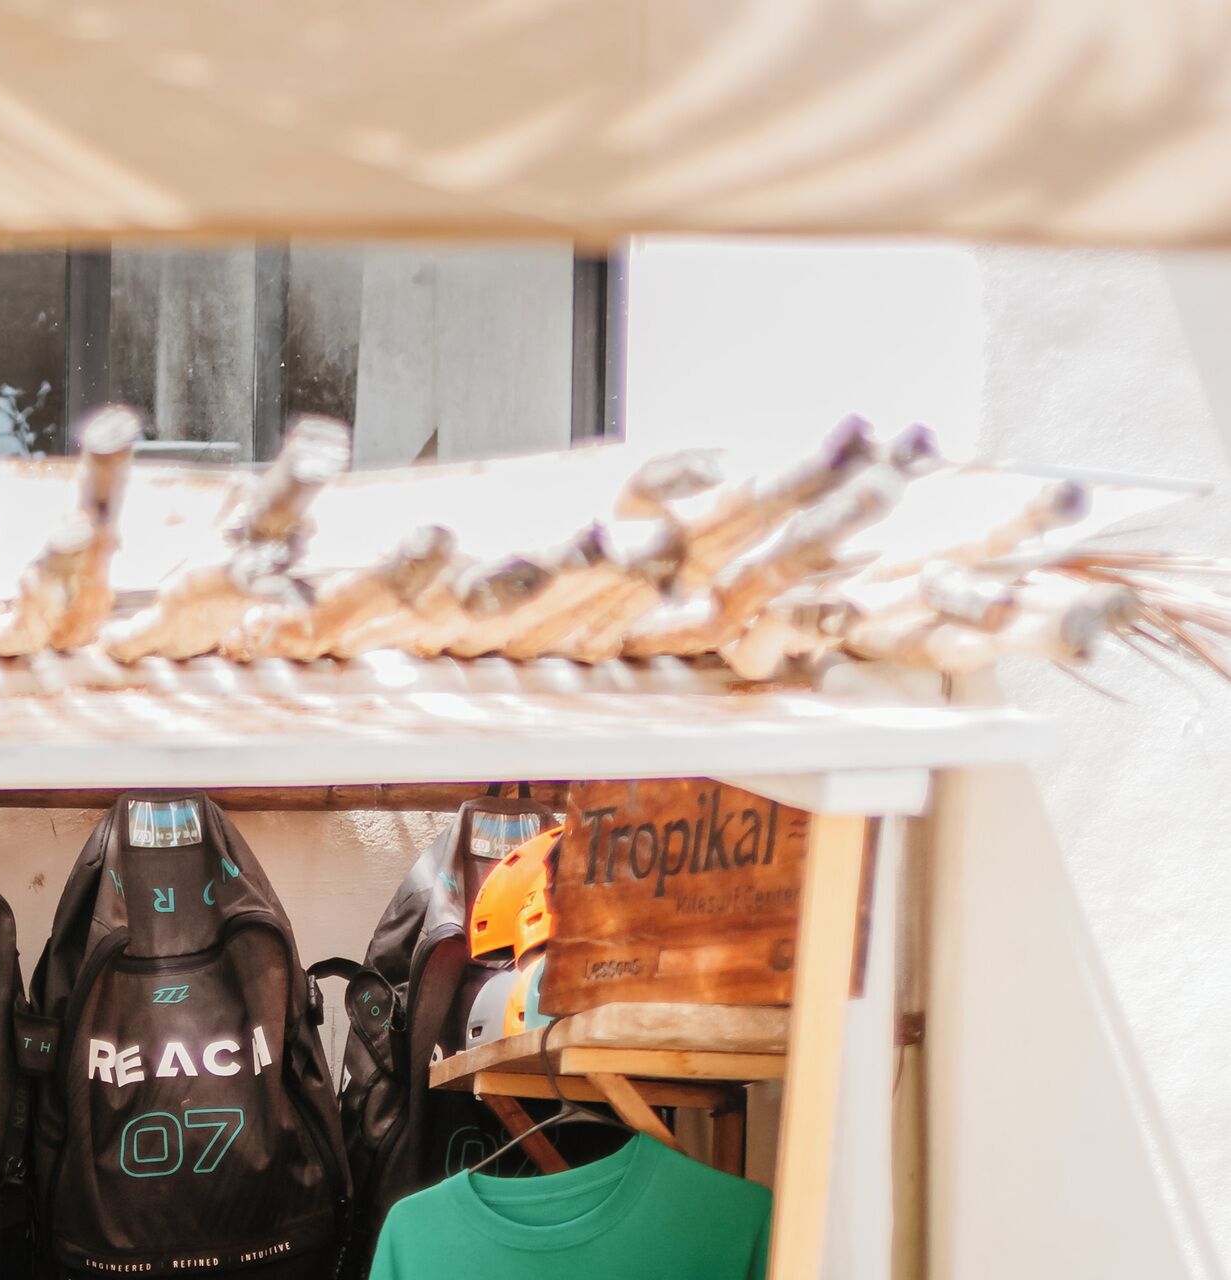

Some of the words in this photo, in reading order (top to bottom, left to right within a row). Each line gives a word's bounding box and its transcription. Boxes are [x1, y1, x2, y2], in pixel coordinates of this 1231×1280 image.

[583, 786, 778, 897] Tropikal
[88, 1025, 273, 1088] REACH
[119, 1108, 245, 1178] 07
[85, 1258, 152, 1273] ENGINEERED
[172, 1257, 219, 1269] REFINED
[240, 1241, 291, 1263] INTUITIVE
